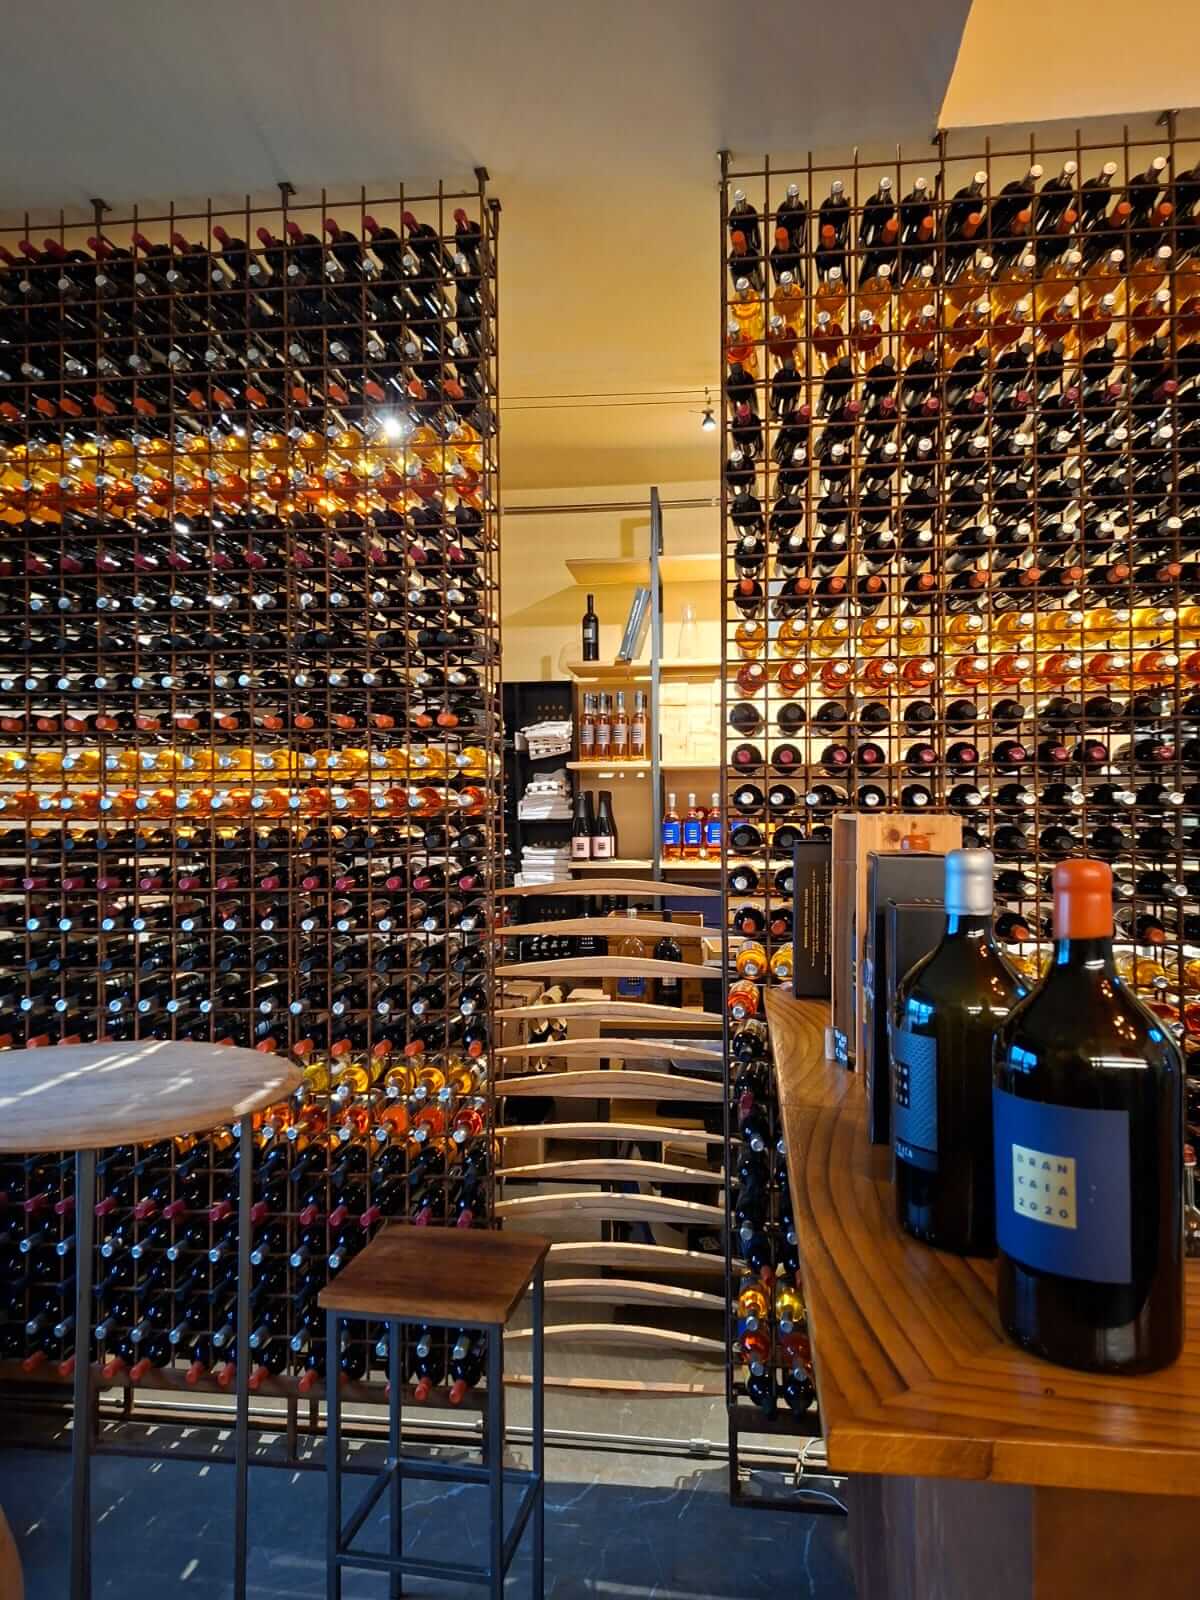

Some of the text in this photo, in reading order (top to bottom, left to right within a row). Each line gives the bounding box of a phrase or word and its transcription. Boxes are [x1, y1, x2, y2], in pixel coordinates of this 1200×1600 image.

[1017, 1153, 1067, 1174] BRAN
[1018, 1175, 1068, 1196] CAIA
[1019, 1197, 1068, 1218] 2020
